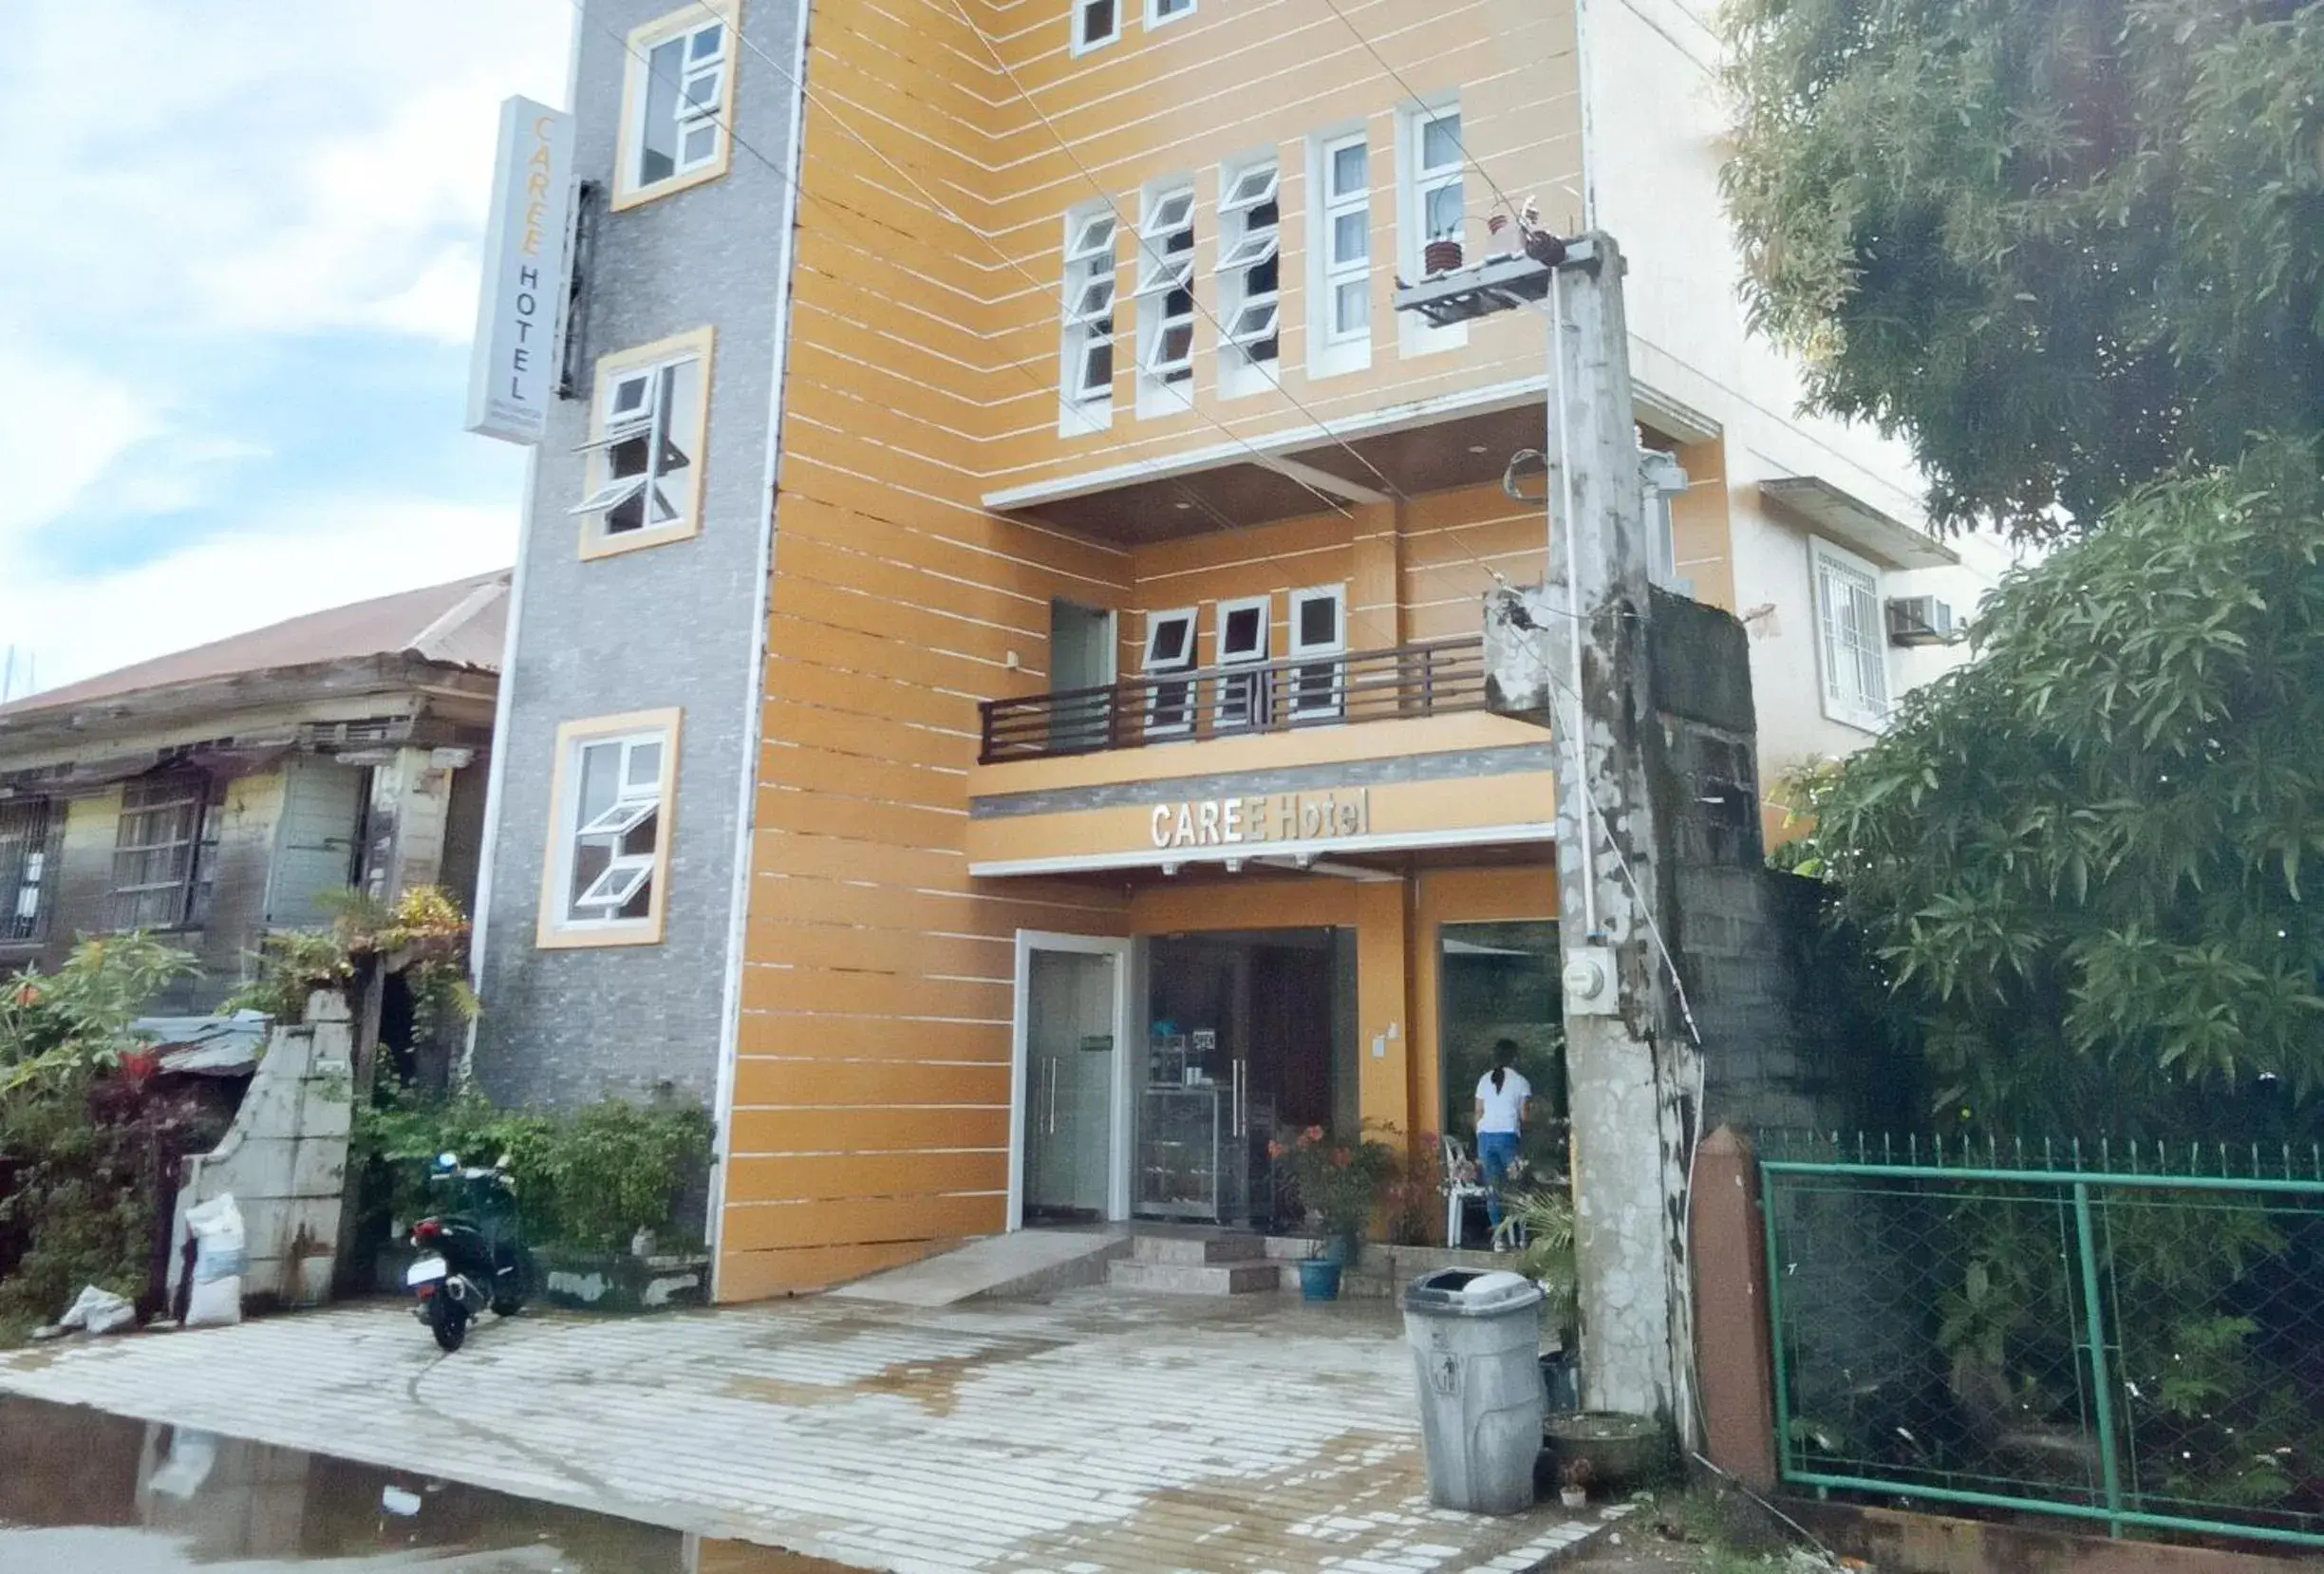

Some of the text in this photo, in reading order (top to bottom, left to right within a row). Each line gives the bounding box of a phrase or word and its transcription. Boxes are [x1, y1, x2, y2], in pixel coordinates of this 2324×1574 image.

[520, 115, 556, 257] CAREE
[511, 264, 539, 402] HOTEL
[1151, 787, 1369, 850] CAREE Hotel
